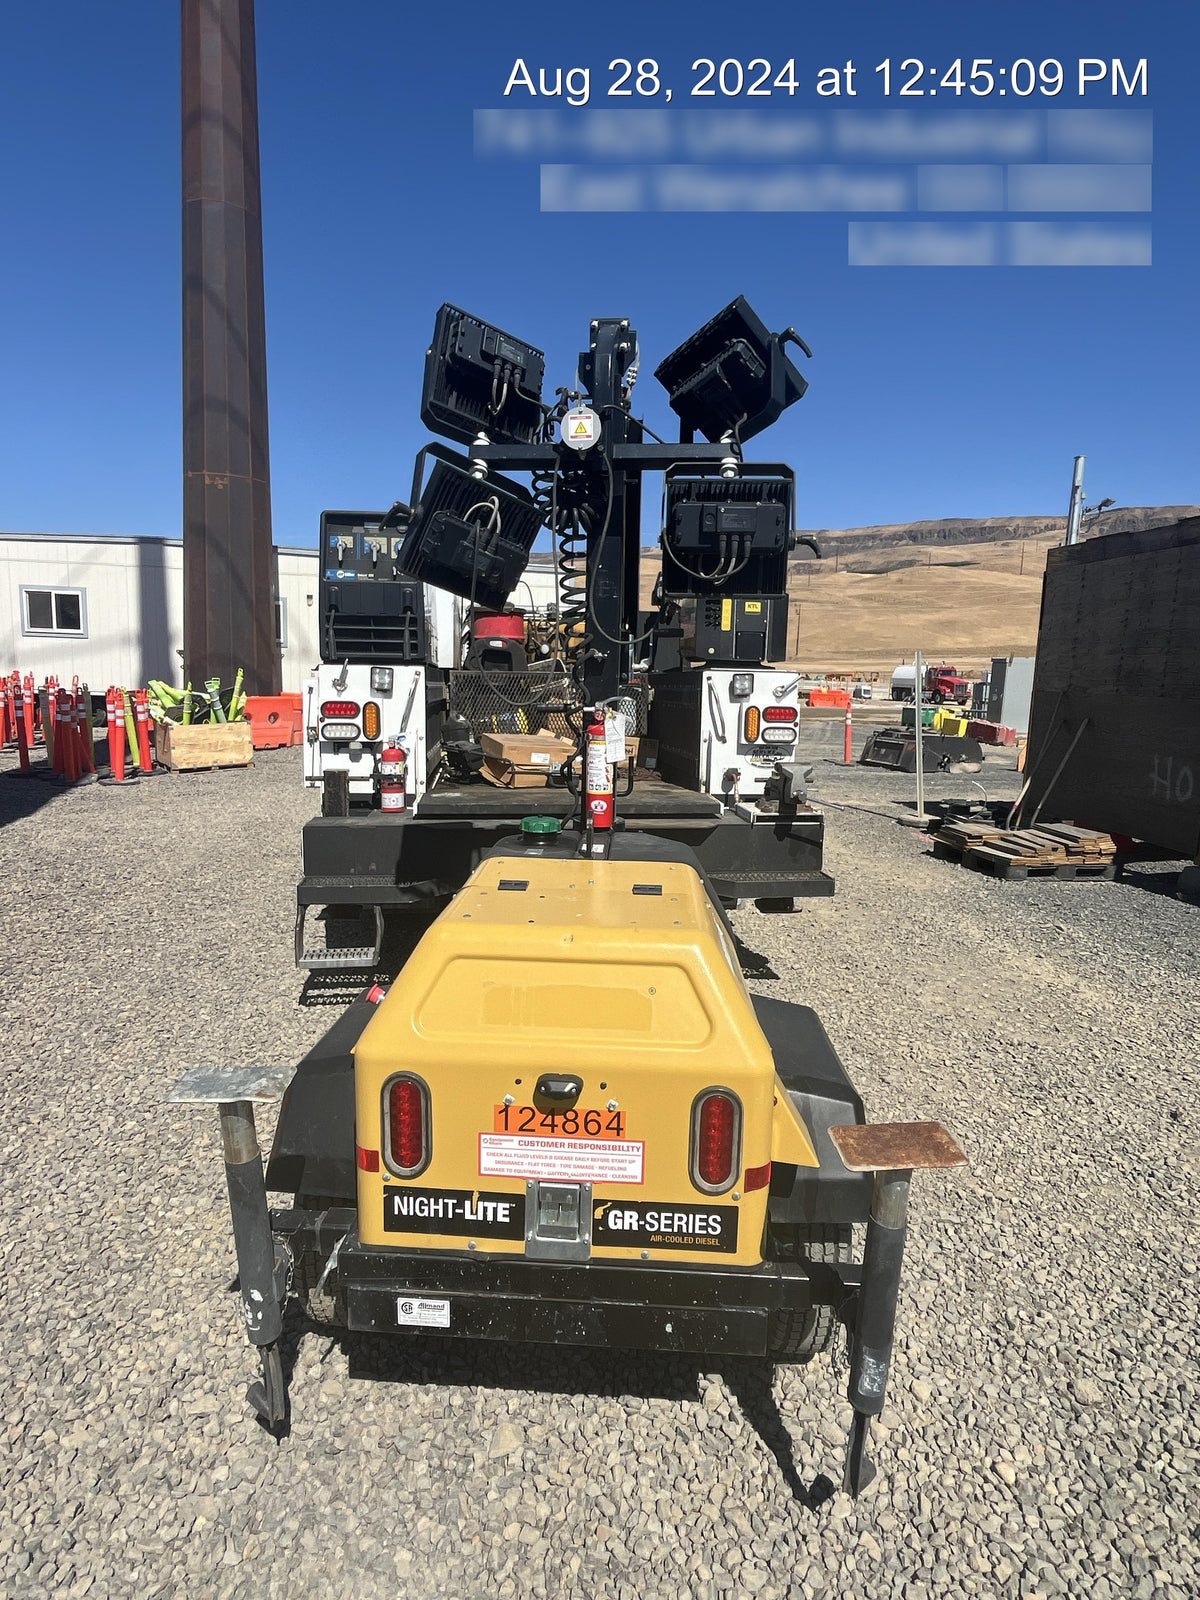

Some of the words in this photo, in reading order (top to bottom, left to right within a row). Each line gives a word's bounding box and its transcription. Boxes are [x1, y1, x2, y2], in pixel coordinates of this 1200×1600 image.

[498, 1104, 624, 1137] 124864
[518, 1139, 566, 1149] CUSTOMER
[567, 1142, 641, 1153] RESPONSIBILITY
[608, 1210, 722, 1235] GR-SERIES
[650, 1234, 694, 1244] AIR-COOLED
[695, 1237, 721, 1246] DIESEL
